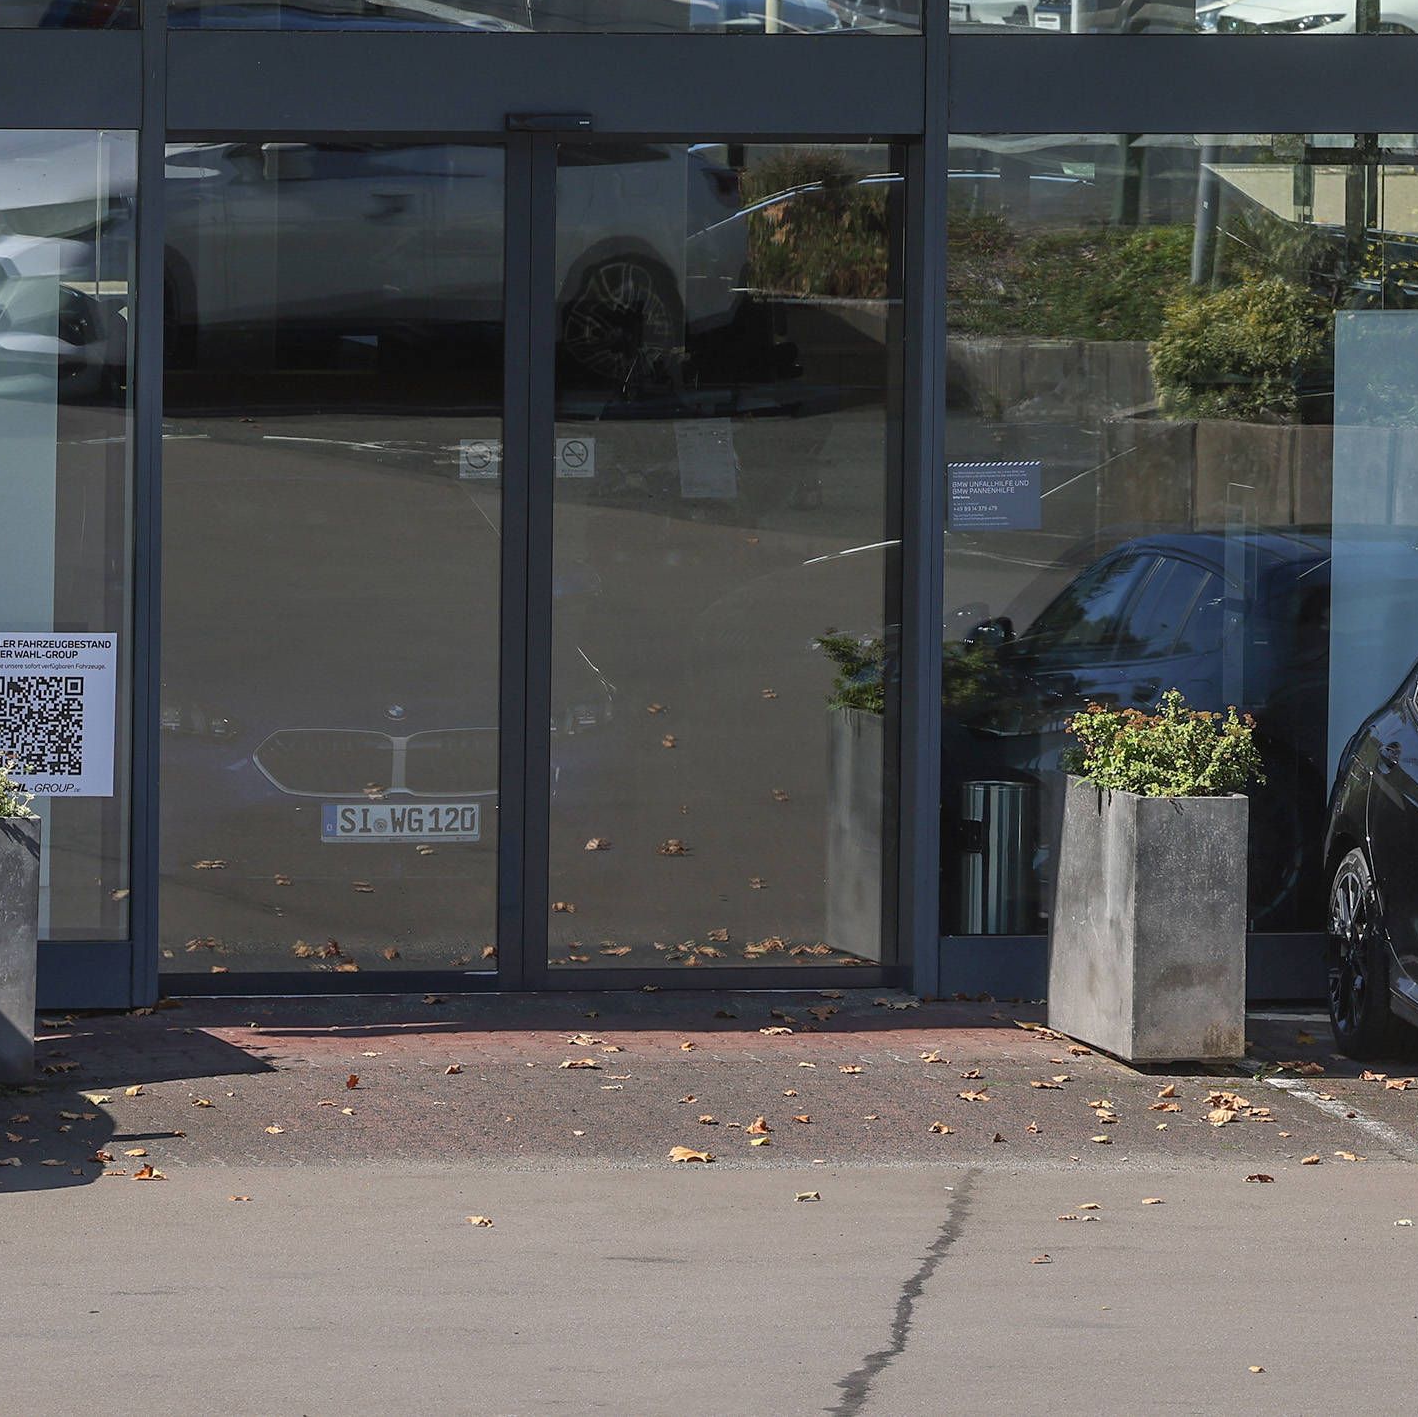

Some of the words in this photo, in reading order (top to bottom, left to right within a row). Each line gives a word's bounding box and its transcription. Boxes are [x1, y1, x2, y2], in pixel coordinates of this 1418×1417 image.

[18, 640, 111, 648] FAHRZEUGBESTAND
[340, 809, 372, 834] SI
[390, 809, 422, 834] WG
[429, 808, 476, 833] 120
